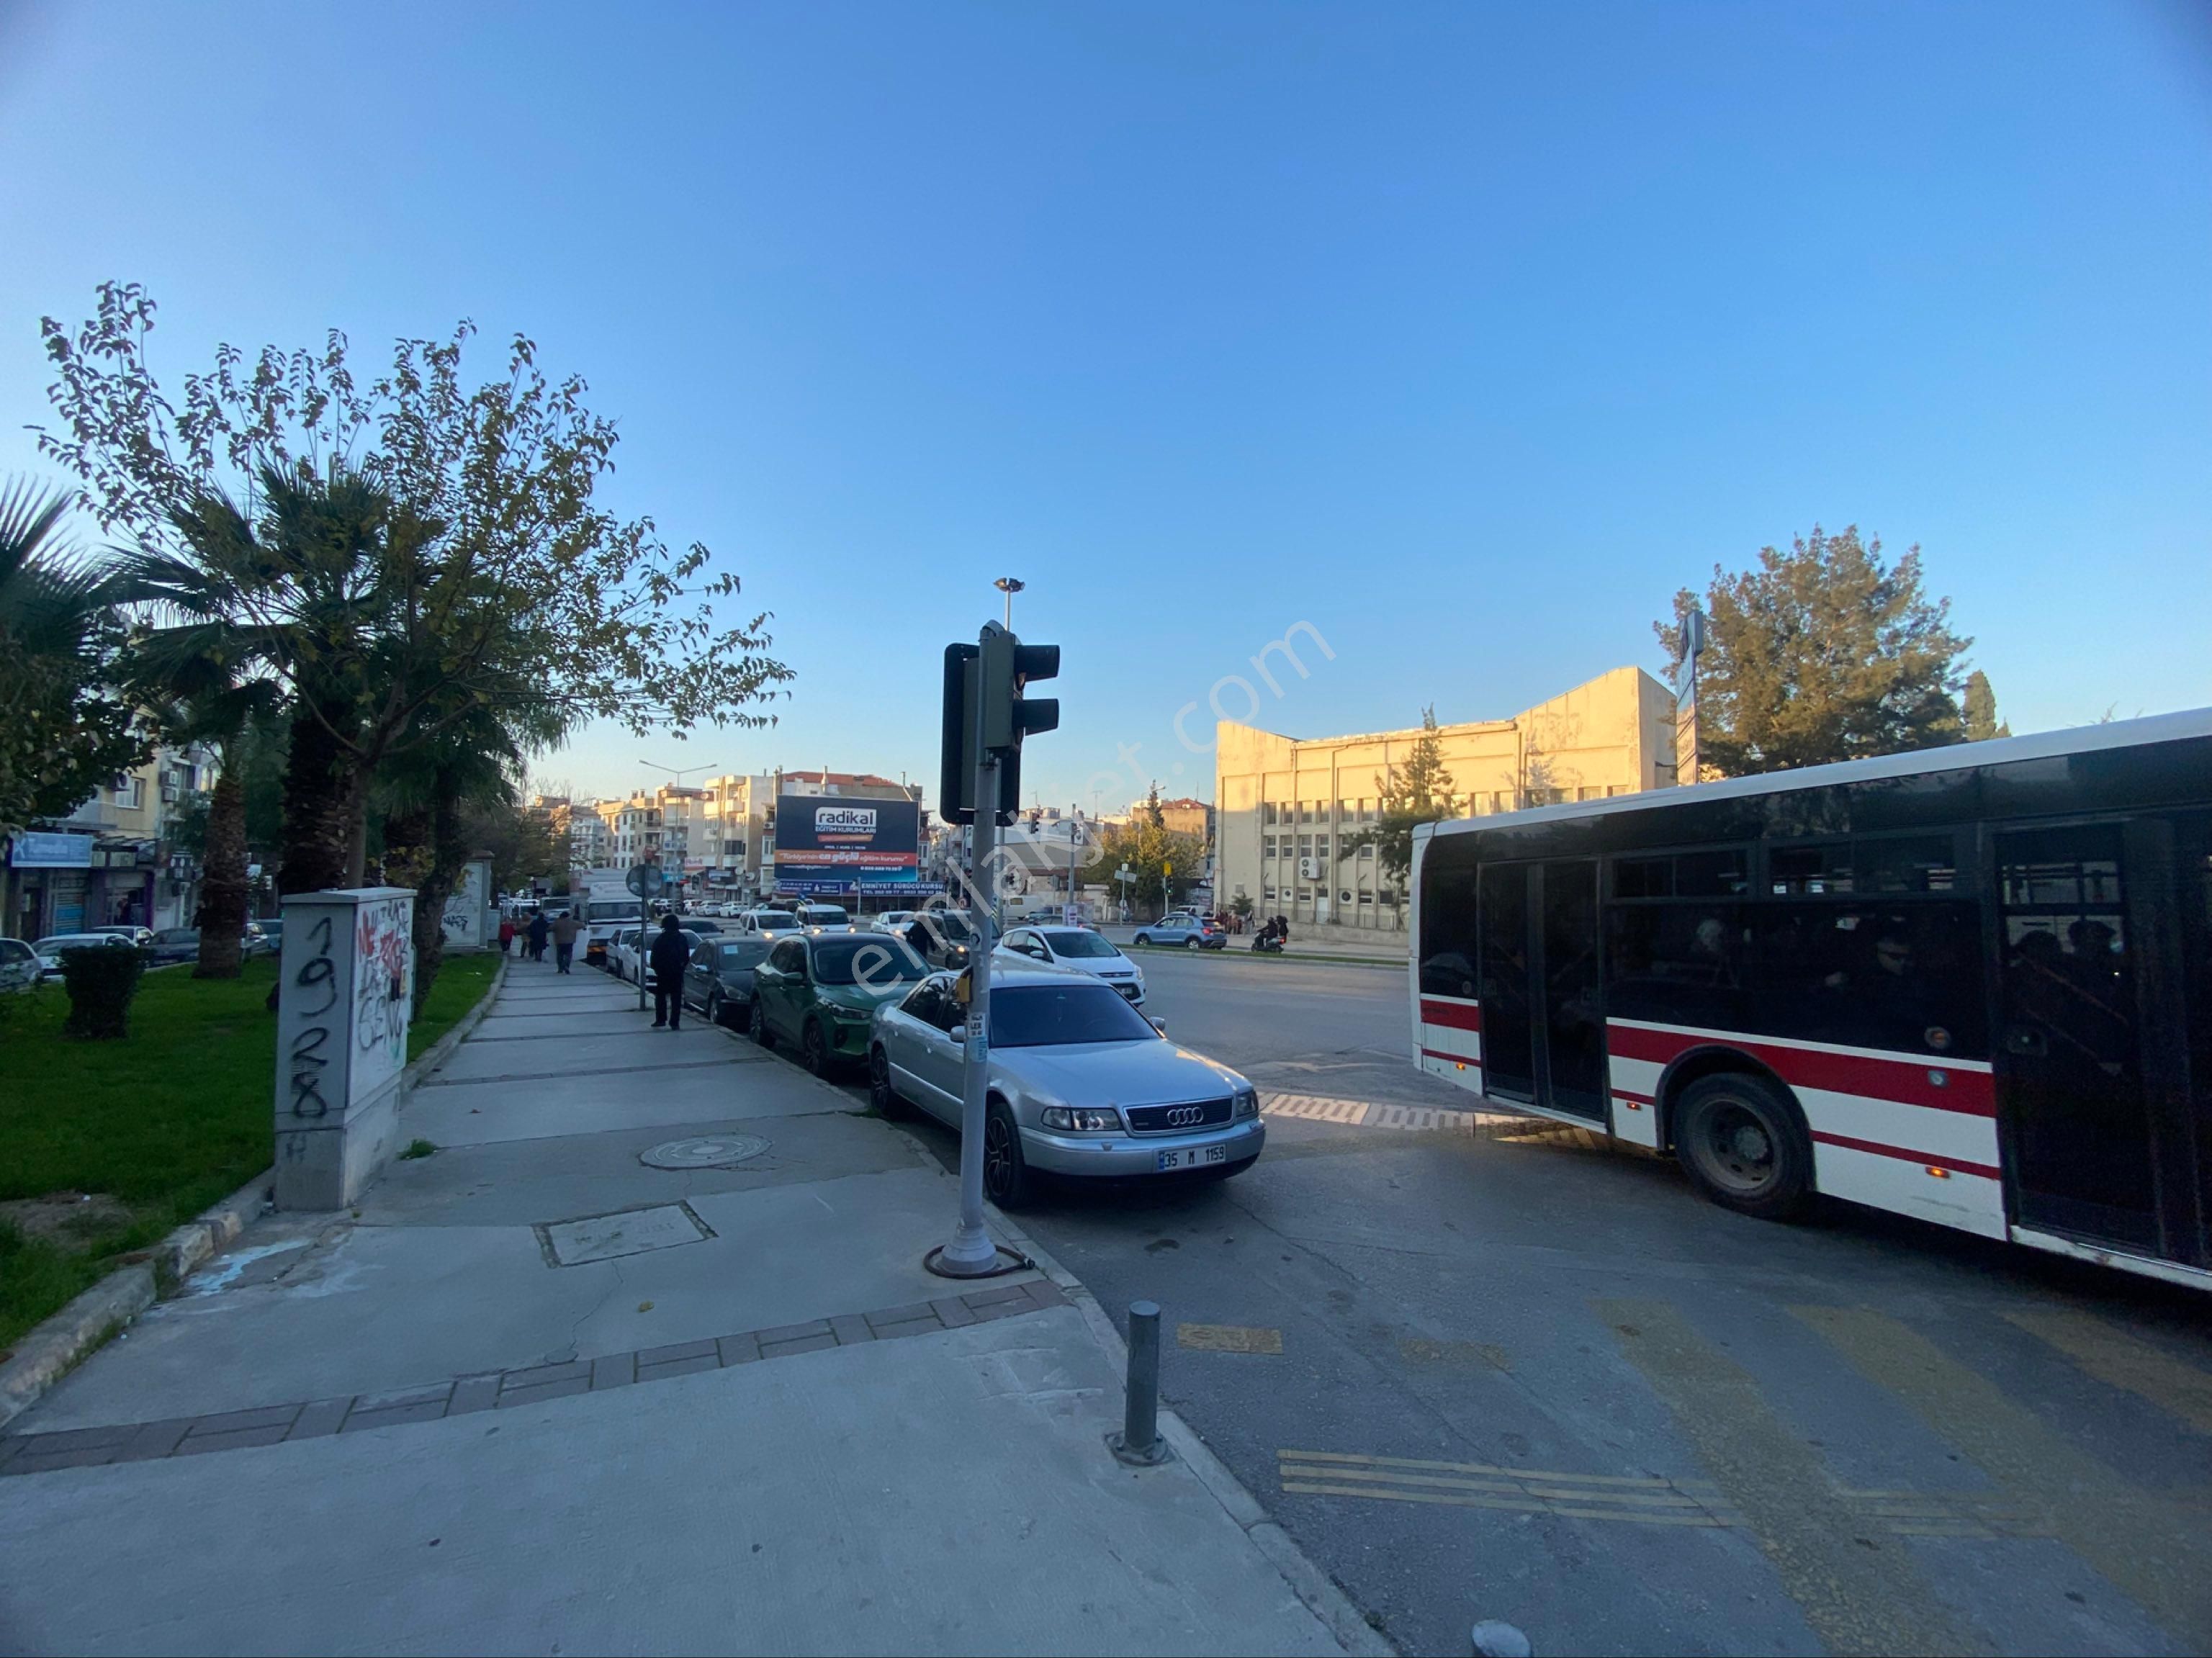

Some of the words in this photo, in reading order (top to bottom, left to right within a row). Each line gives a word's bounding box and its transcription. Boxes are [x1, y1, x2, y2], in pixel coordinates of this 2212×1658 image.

[819, 810, 873, 825] radikal
[832, 852, 859, 862] güçlü
[1164, 1153, 1178, 1166] 35
[1205, 1146, 1224, 1162] 1159
